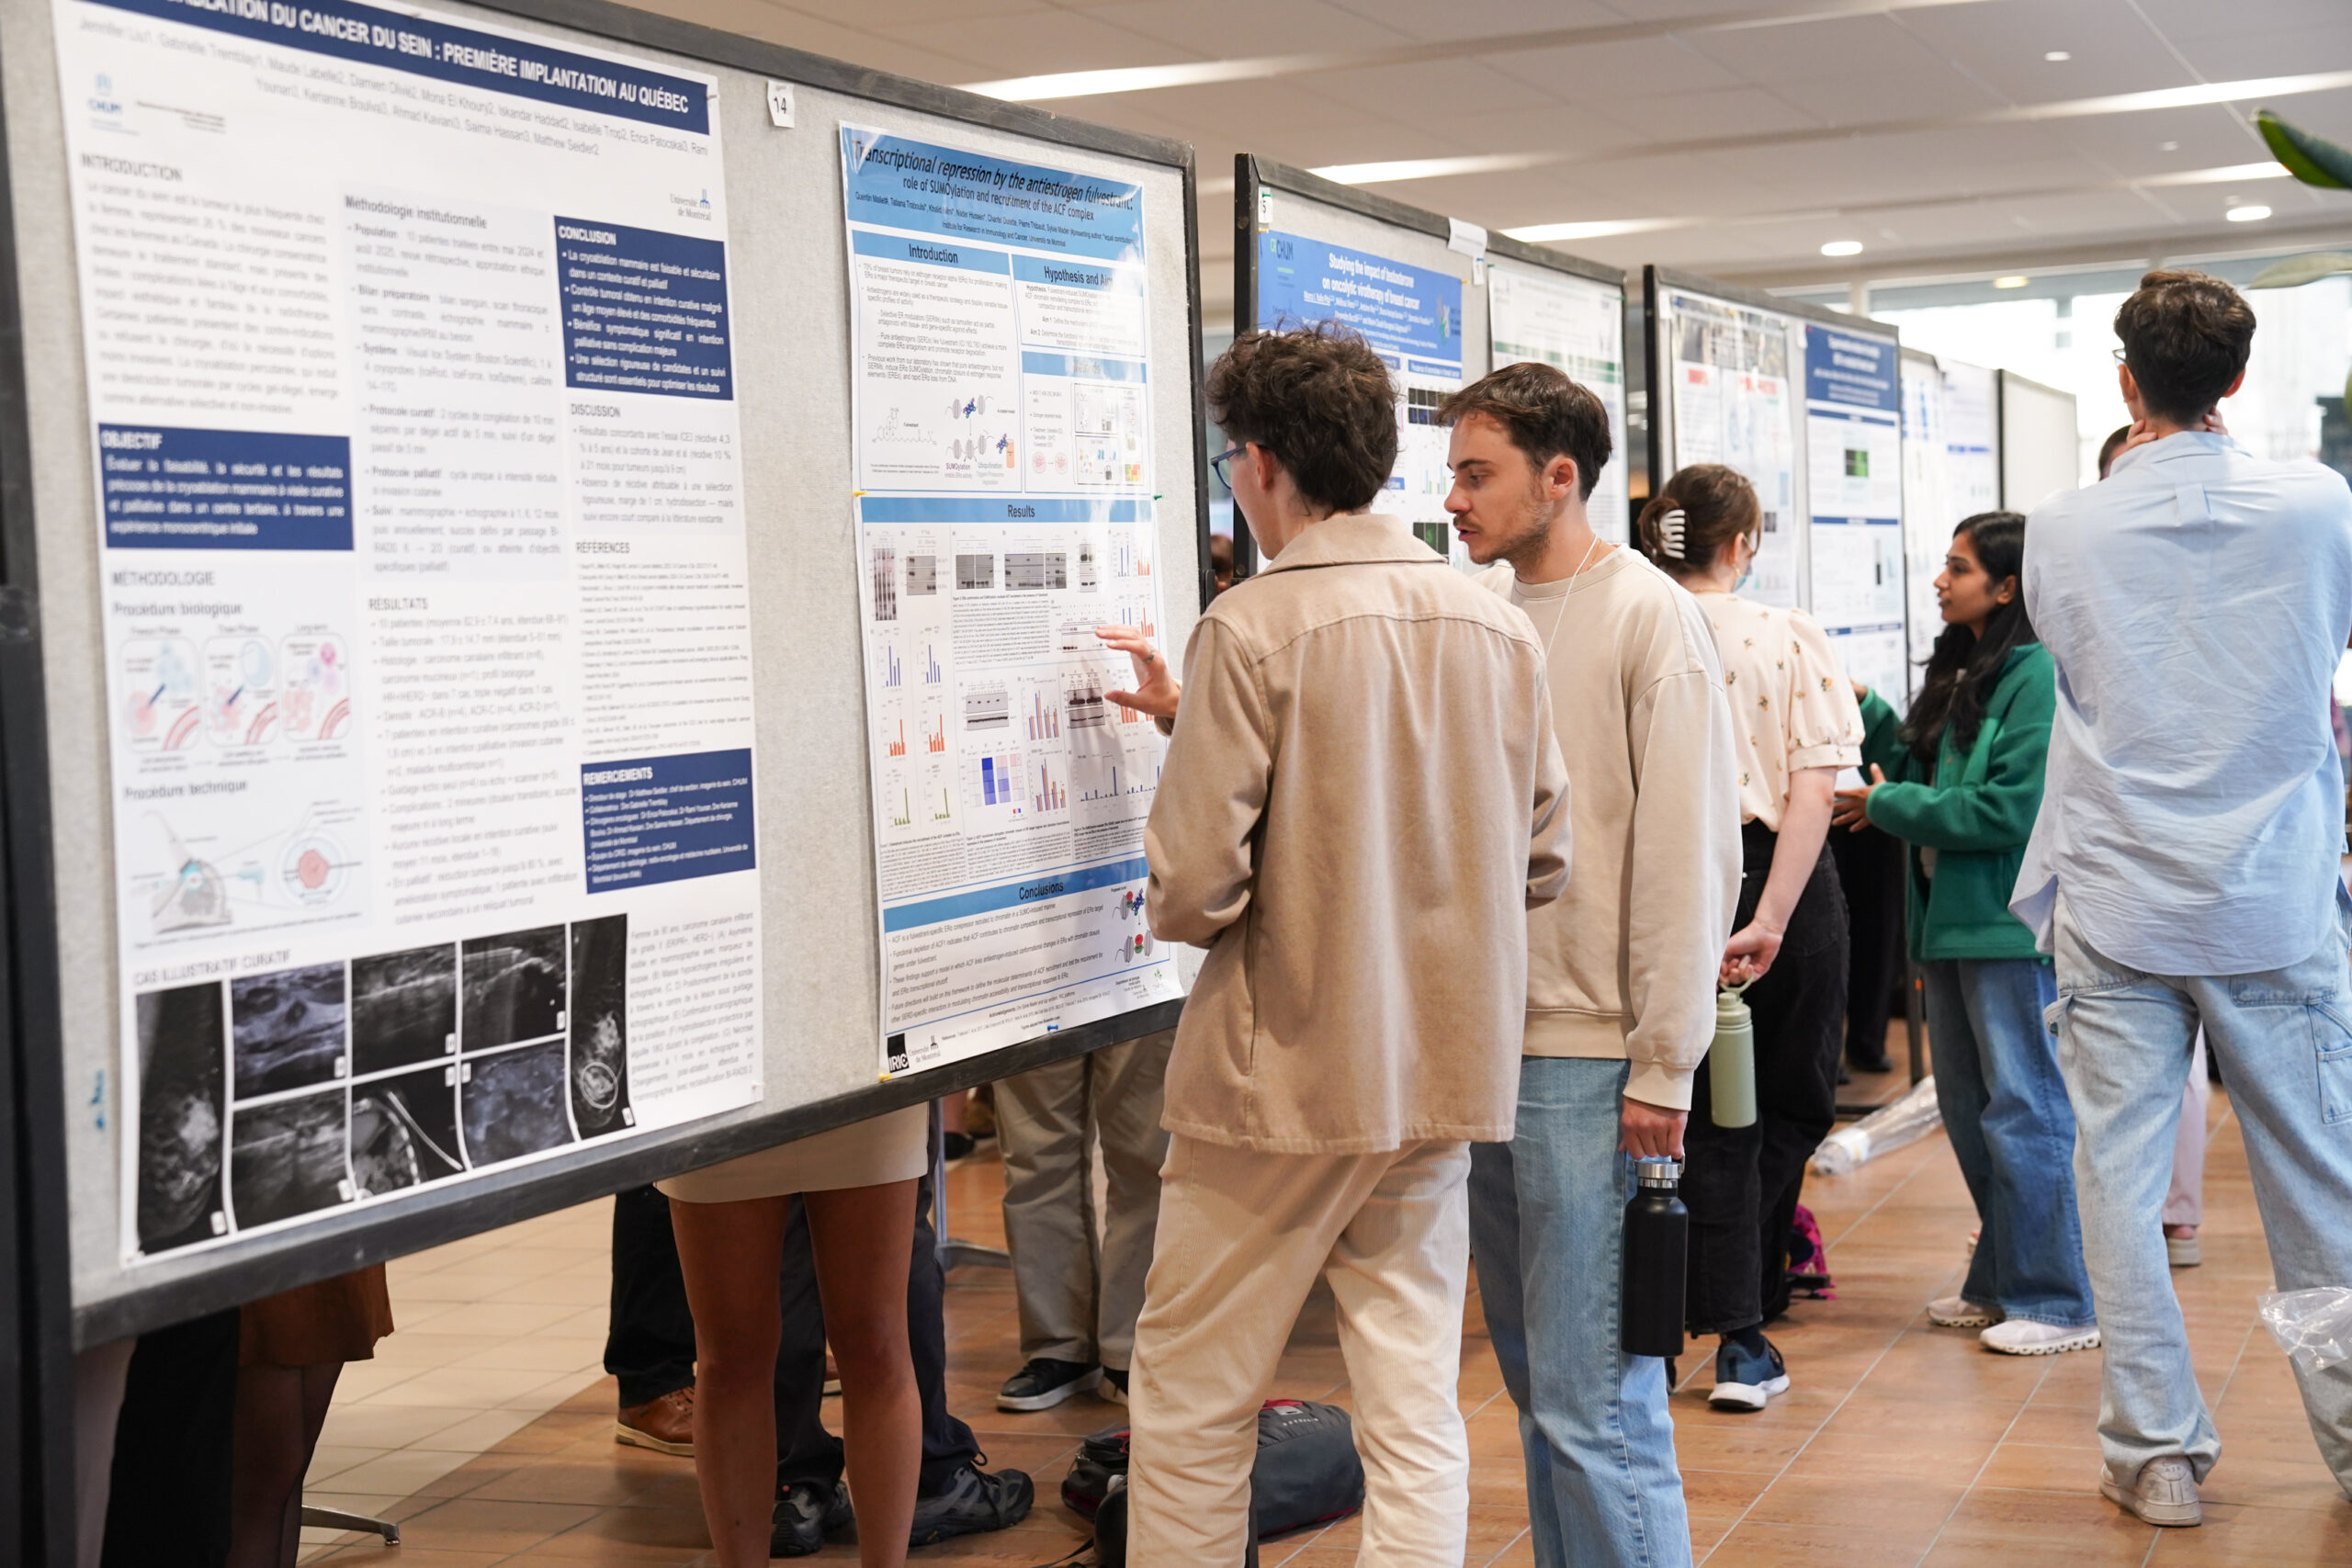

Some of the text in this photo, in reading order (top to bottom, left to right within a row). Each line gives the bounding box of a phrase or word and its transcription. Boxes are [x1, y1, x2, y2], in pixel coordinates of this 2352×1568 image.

[271, 5, 296, 28] DU
[300, 11, 369, 42] CANCER
[372, 26, 396, 50] DU
[398, 32, 432, 57] SEIN
[443, 43, 517, 75] PREMIÈRE
[520, 61, 616, 96] IMPLANTATION
[618, 83, 637, 102] AU
[639, 86, 689, 114] QUÉBEC
[774, 96, 787, 115] 14
[81, 153, 182, 180] INTRODUCTION
[937, 162, 992, 184] repression
[993, 168, 1007, 190] by
[1008, 169, 1025, 189] the
[1026, 177, 1083, 202] antiestrogen
[903, 175, 918, 190] role
[928, 179, 975, 199] SUMOylation
[976, 187, 989, 203] and
[991, 193, 1031, 209] recruitment
[1040, 197, 1052, 213] the
[1054, 202, 1066, 216] ACF
[1068, 207, 1094, 221] complex
[558, 226, 616, 245] CONCLUSION
[909, 243, 958, 264] Introduction
[1044, 266, 1112, 286] Hypothesis and Aim
[571, 403, 620, 418] DISCUSSION
[101, 431, 162, 449] OBJECTIF
[1008, 504, 1035, 519] Results
[1019, 882, 1064, 900] Conclusions
[888, 1053, 909, 1073] IRIC
